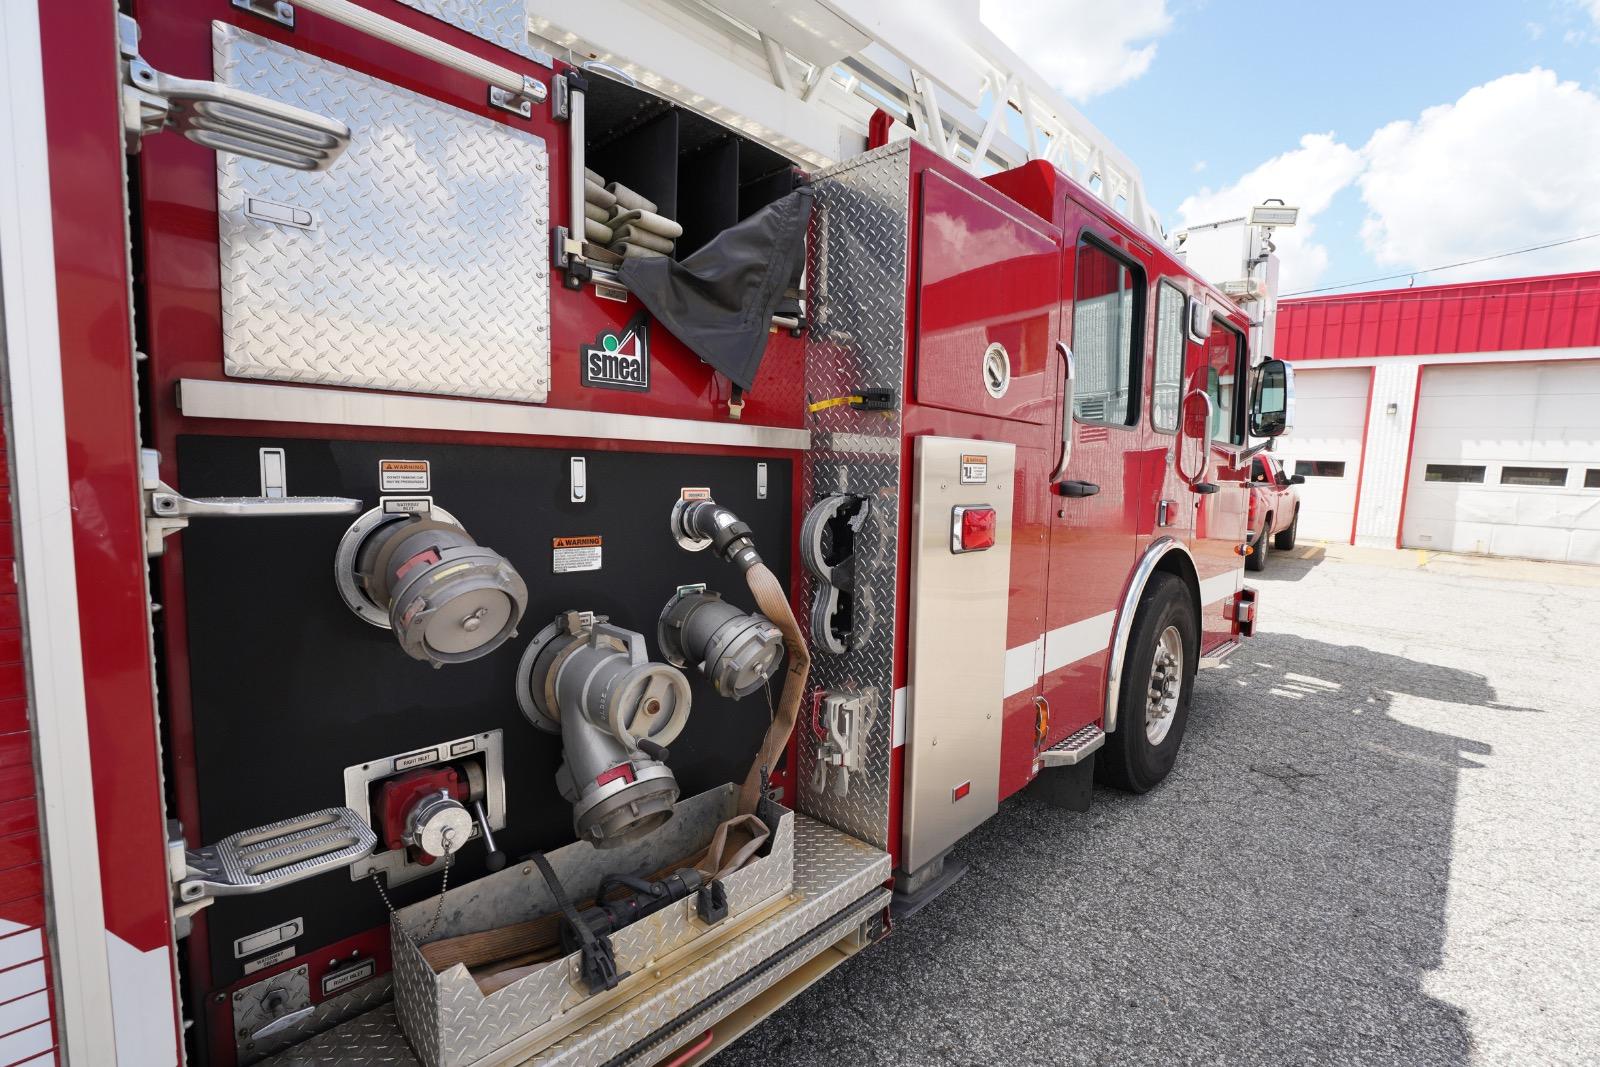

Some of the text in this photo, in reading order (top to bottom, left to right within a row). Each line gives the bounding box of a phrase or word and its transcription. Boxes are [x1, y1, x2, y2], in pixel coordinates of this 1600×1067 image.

[589, 326, 647, 384] smeal
[565, 537, 600, 546] WARNING
[403, 758, 417, 766] RIGHT
